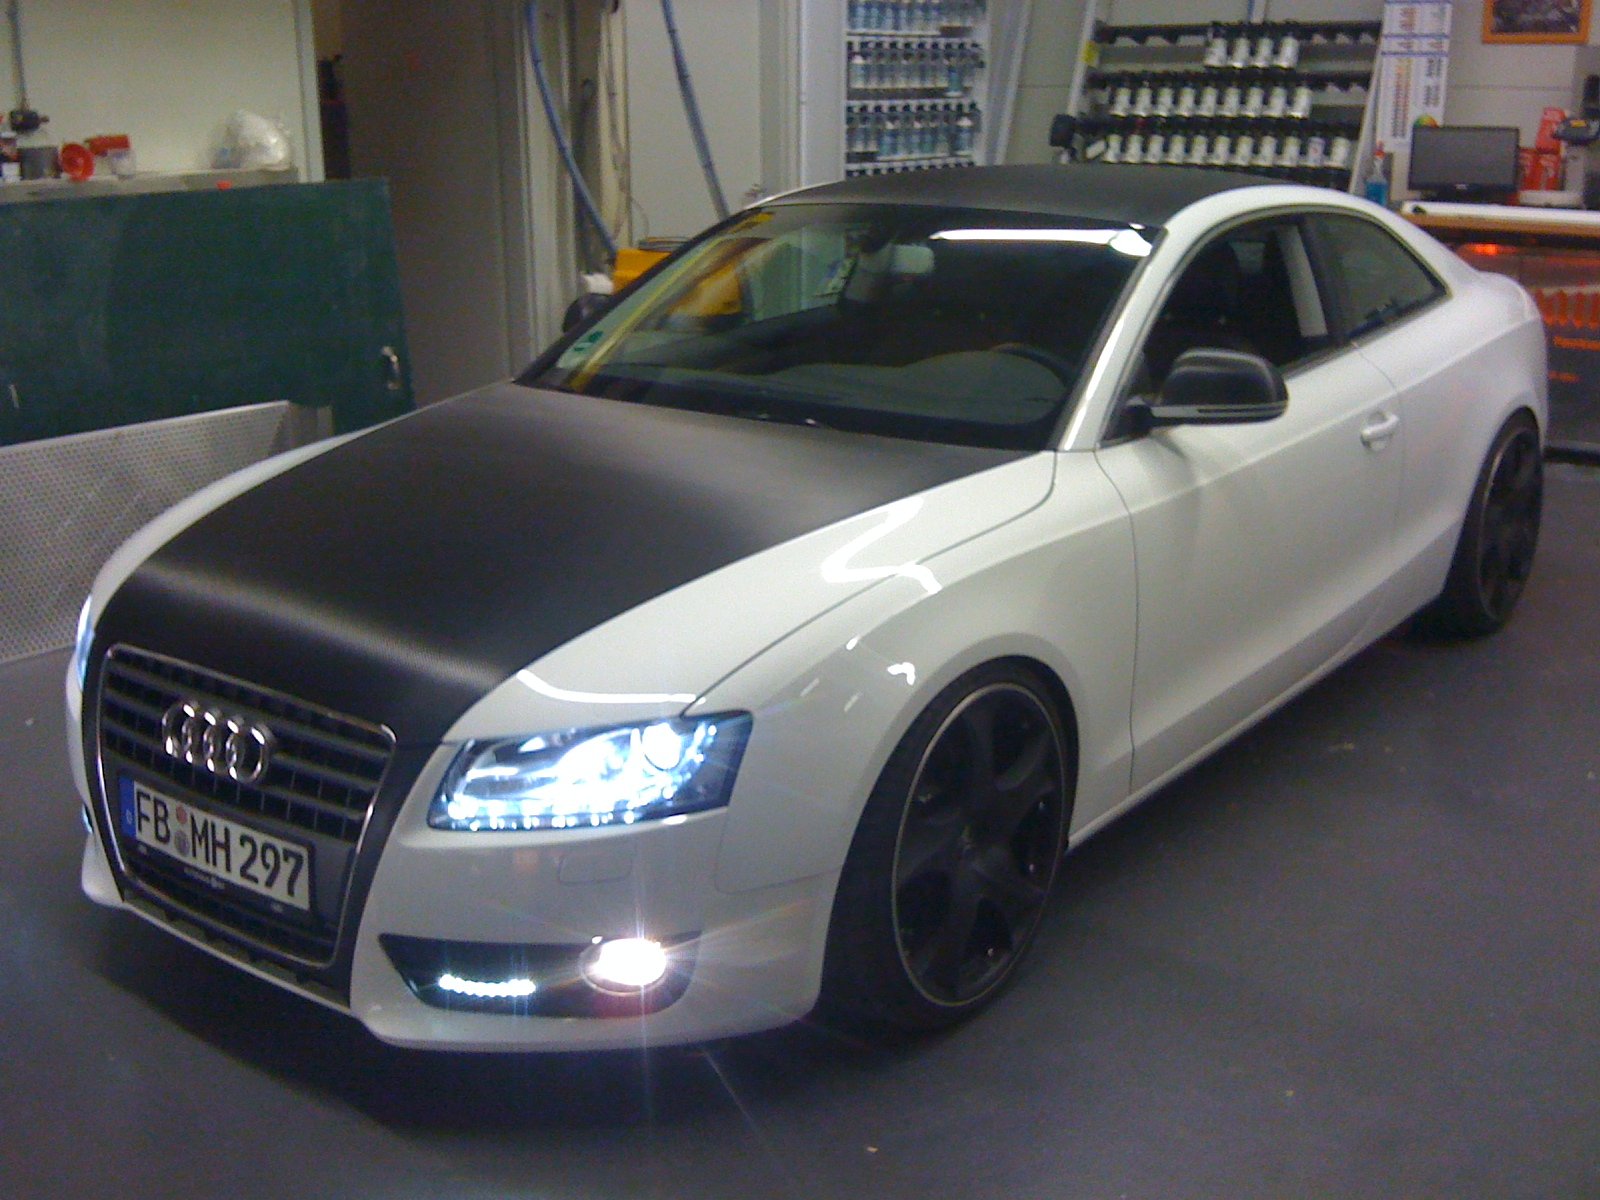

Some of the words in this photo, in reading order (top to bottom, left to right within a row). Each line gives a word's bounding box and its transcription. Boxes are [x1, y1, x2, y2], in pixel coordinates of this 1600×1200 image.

[136, 791, 170, 843] FB
[190, 816, 230, 873] MH
[239, 834, 303, 897] 297
